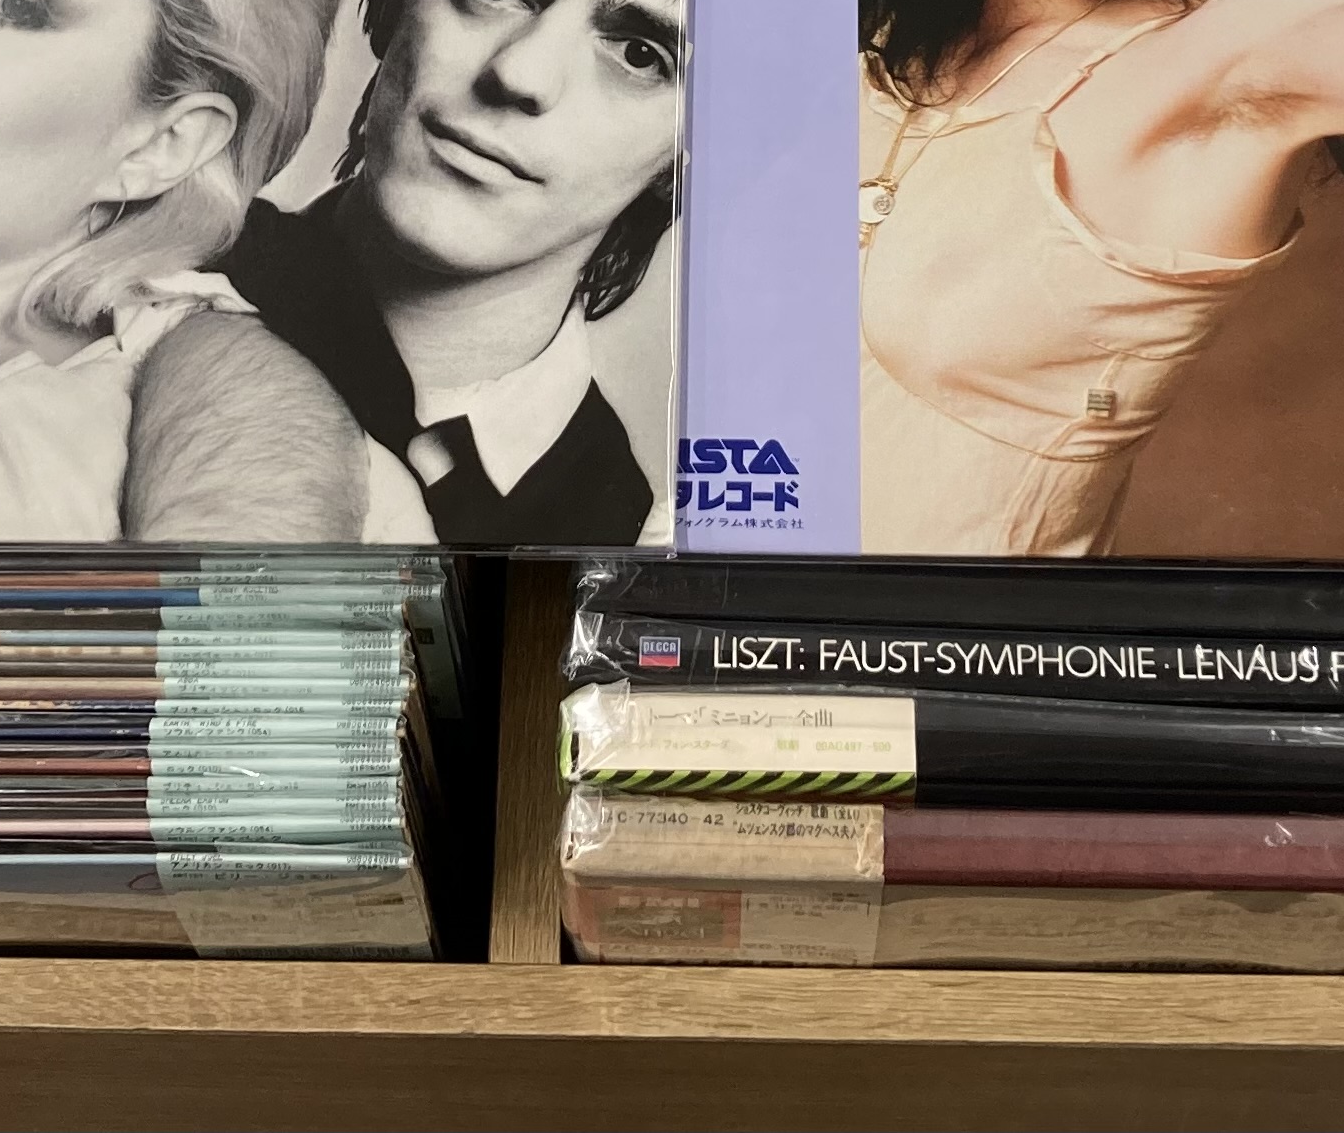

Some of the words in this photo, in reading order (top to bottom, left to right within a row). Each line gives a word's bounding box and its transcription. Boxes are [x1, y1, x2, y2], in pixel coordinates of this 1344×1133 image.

[677, 438, 799, 475] ISTA
[643, 642, 677, 654] DECCA
[713, 636, 806, 671] LISZT:
